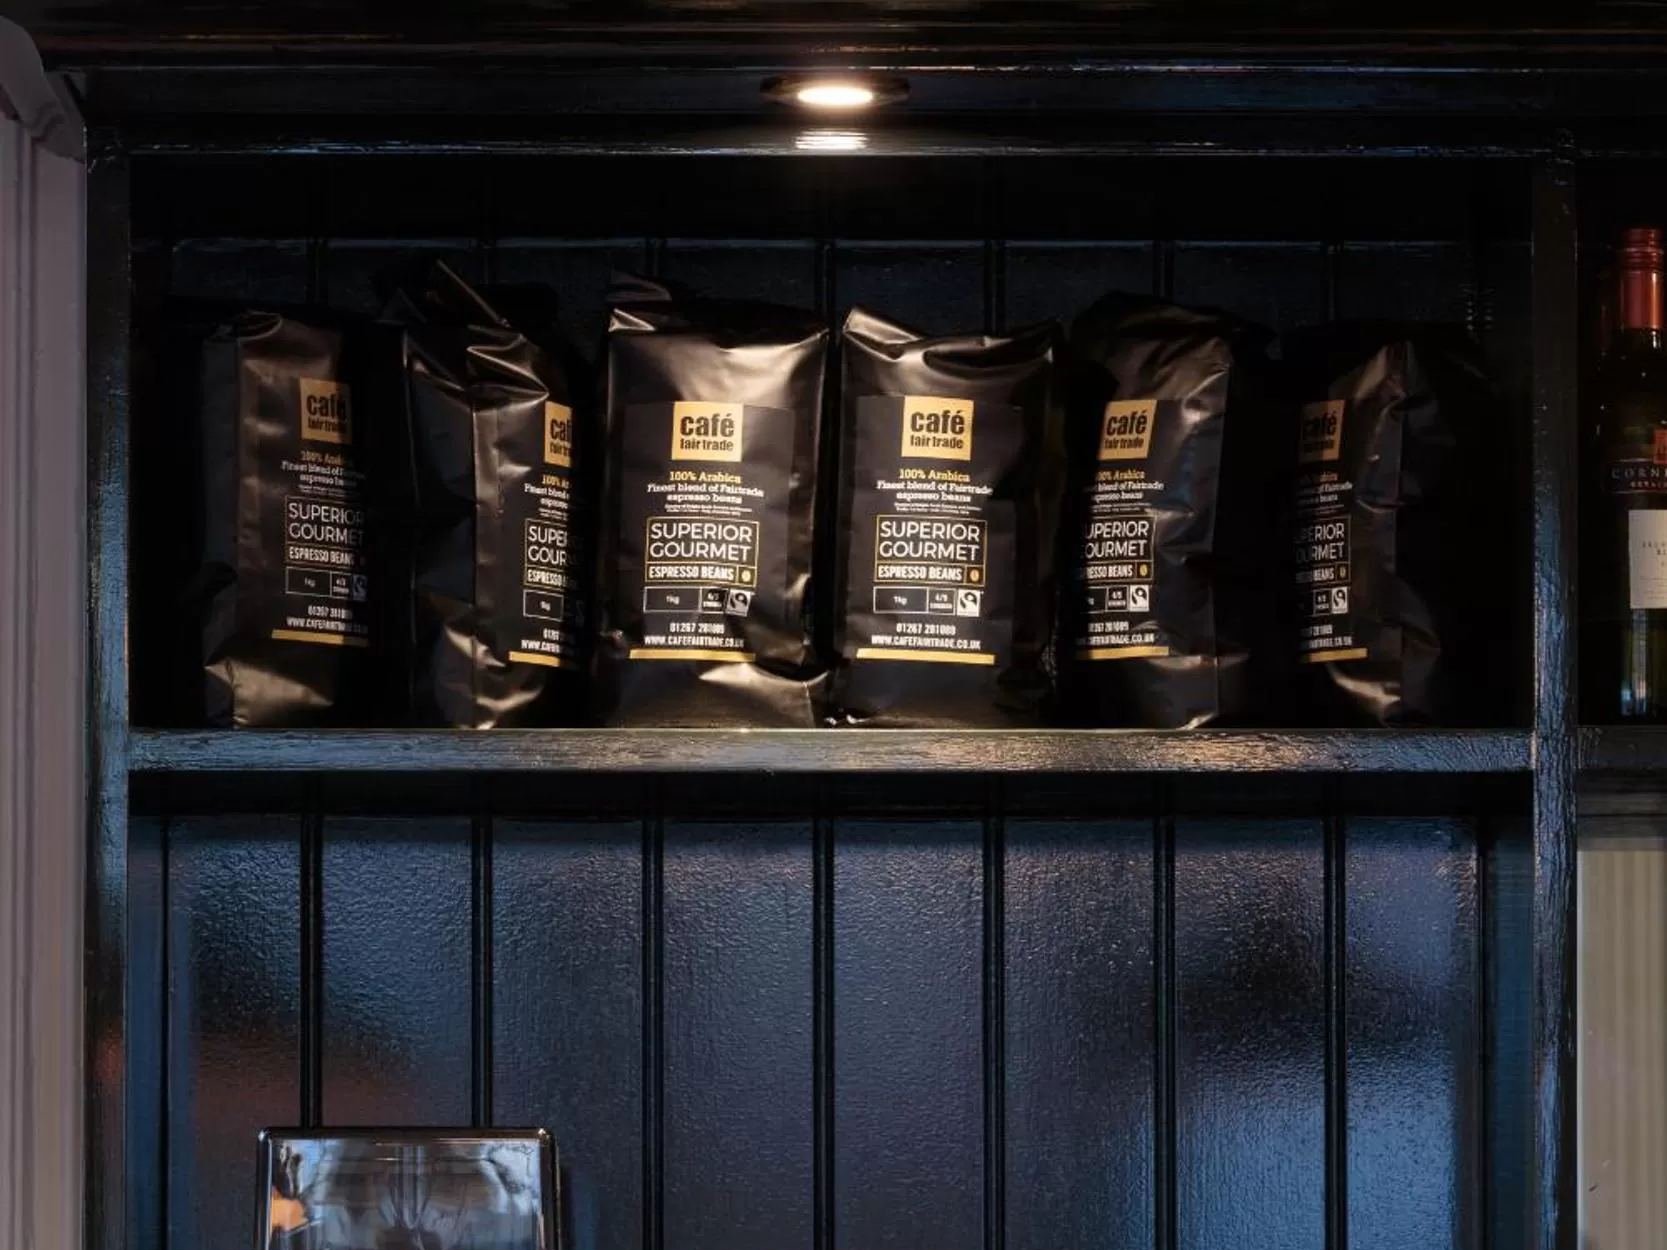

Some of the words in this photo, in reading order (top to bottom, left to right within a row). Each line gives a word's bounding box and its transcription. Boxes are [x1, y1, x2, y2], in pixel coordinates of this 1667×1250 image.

[680, 413, 735, 437] café
[911, 410, 965, 436] café
[1106, 409, 1148, 436] café
[670, 471, 697, 481] 100%
[699, 472, 741, 483] Arabica
[899, 468, 926, 479] 100%
[928, 469, 970, 482] Arabica
[678, 483, 706, 492] blend
[877, 480, 905, 490] Finest
[907, 480, 936, 490] blend
[937, 482, 947, 491] of
[949, 482, 993, 495] Fairtrade
[896, 491, 940, 502] espresso
[941, 492, 972, 502] beans
[288, 503, 363, 525] SUPERIOR
[288, 523, 363, 546] GOURMET
[651, 522, 752, 543] SUPERIOR
[880, 521, 980, 542] SUPERIOR
[1086, 521, 1149, 539] UPERIOR
[289, 546, 329, 563] ESPRESSO
[650, 541, 751, 562] GOURMET
[879, 541, 979, 562] GOURMET
[1085, 540, 1147, 559] OURMET
[649, 564, 699, 579] ESPRESSO
[701, 565, 734, 581] BEANS
[878, 564, 927, 580] ESPRESSO
[928, 565, 963, 581] BEANS
[1108, 563, 1133, 578] BEANS
